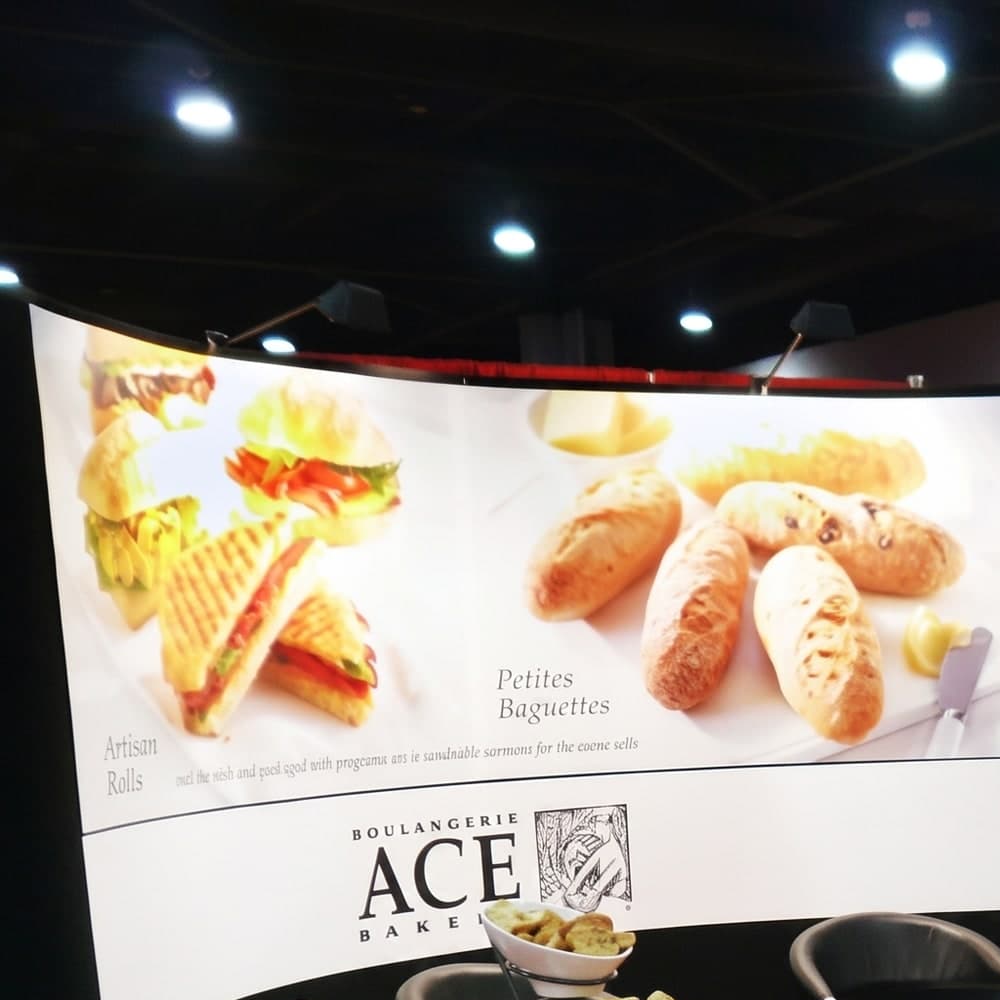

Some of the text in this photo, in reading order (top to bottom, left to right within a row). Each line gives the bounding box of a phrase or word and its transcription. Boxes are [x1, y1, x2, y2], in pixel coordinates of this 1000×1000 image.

[497, 668, 573, 690] Petites
[499, 697, 609, 725] Baguettes
[104, 734, 157, 760] Artisan
[534, 741, 553, 759] for
[556, 740, 574, 753] the
[108, 768, 142, 795] Rolls
[352, 812, 518, 841] BOULANGERIE
[358, 832, 521, 920] ACE
[359, 914, 482, 942] BAKE
